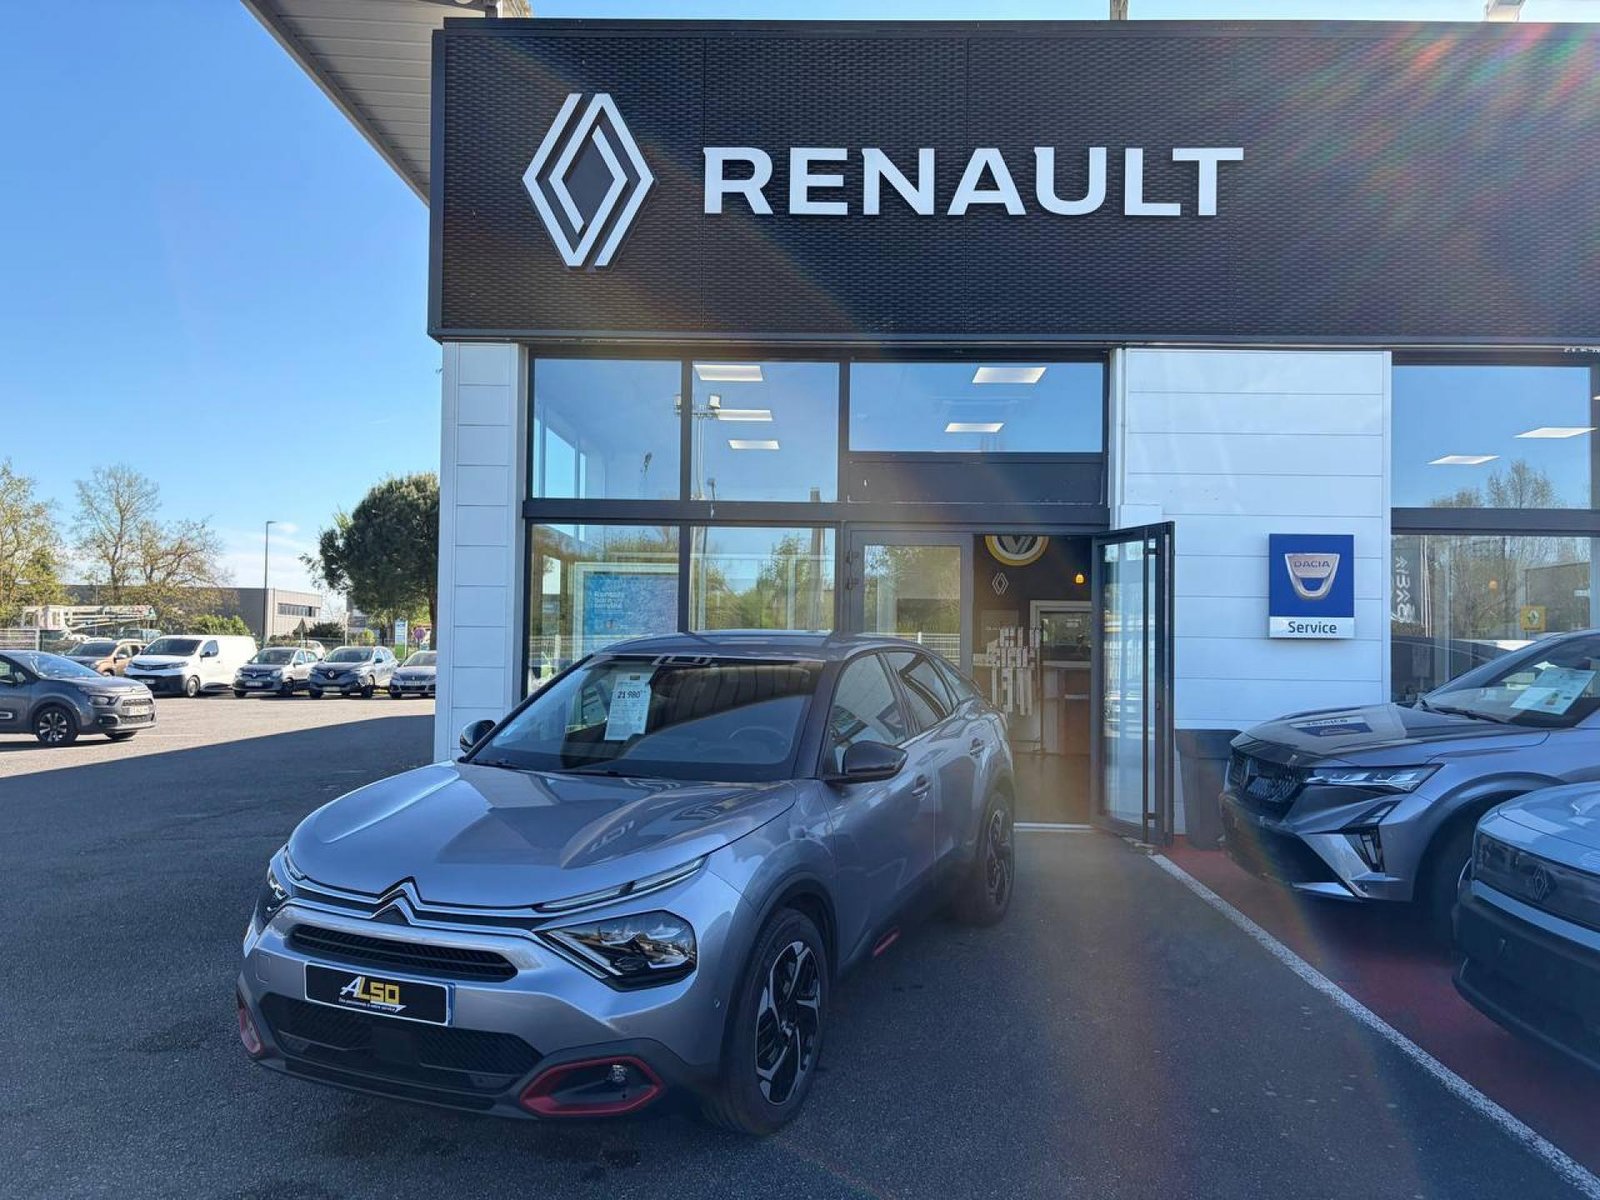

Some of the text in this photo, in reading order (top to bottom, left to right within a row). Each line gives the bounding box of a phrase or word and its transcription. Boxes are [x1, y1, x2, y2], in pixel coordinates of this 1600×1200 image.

[703, 146, 1244, 216] RENAULT
[1294, 560, 1330, 568] DACIA
[1287, 620, 1338, 634] Service
[617, 691, 626, 699] 21
[340, 976, 399, 1004] ALSO
